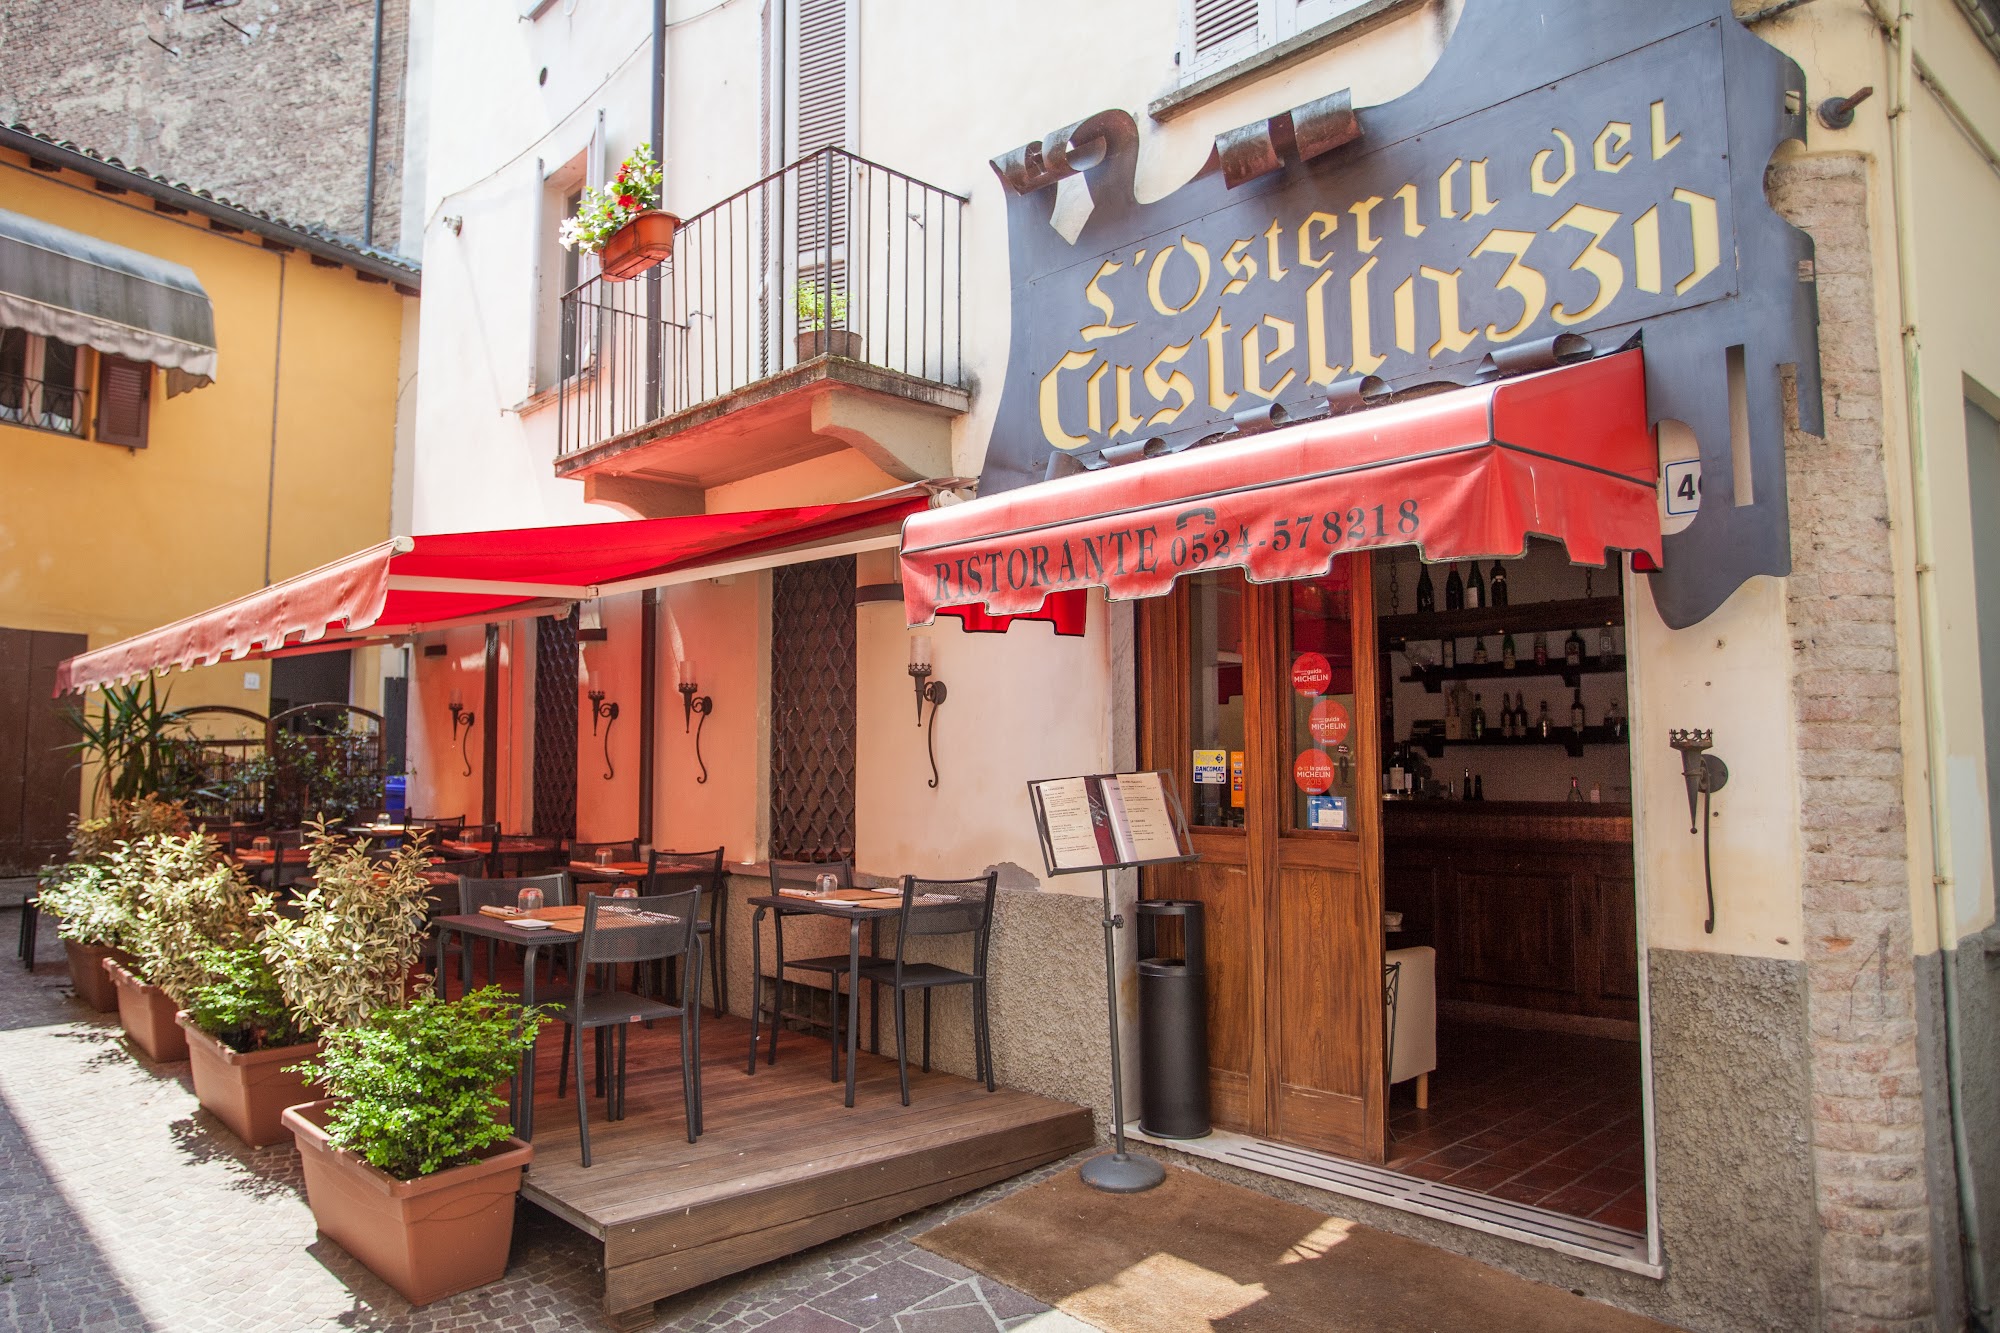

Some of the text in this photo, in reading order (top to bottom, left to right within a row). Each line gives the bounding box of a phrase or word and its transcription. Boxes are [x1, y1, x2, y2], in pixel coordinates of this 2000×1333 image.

[1530, 99, 1682, 198] del
[1038, 186, 1722, 451] Castellazzo
[1677, 473, 1702, 501] 4
[935, 499, 1421, 600] RISTORANTE 0524-578218
[1306, 668, 1322, 676] guida
[1294, 674, 1329, 683] MICHELIN
[1311, 722, 1347, 731] MICHELIN
[1195, 751, 1214, 763] Pago
[1195, 765, 1225, 773] BANCOMAT
[1317, 765, 1331, 773] guida
